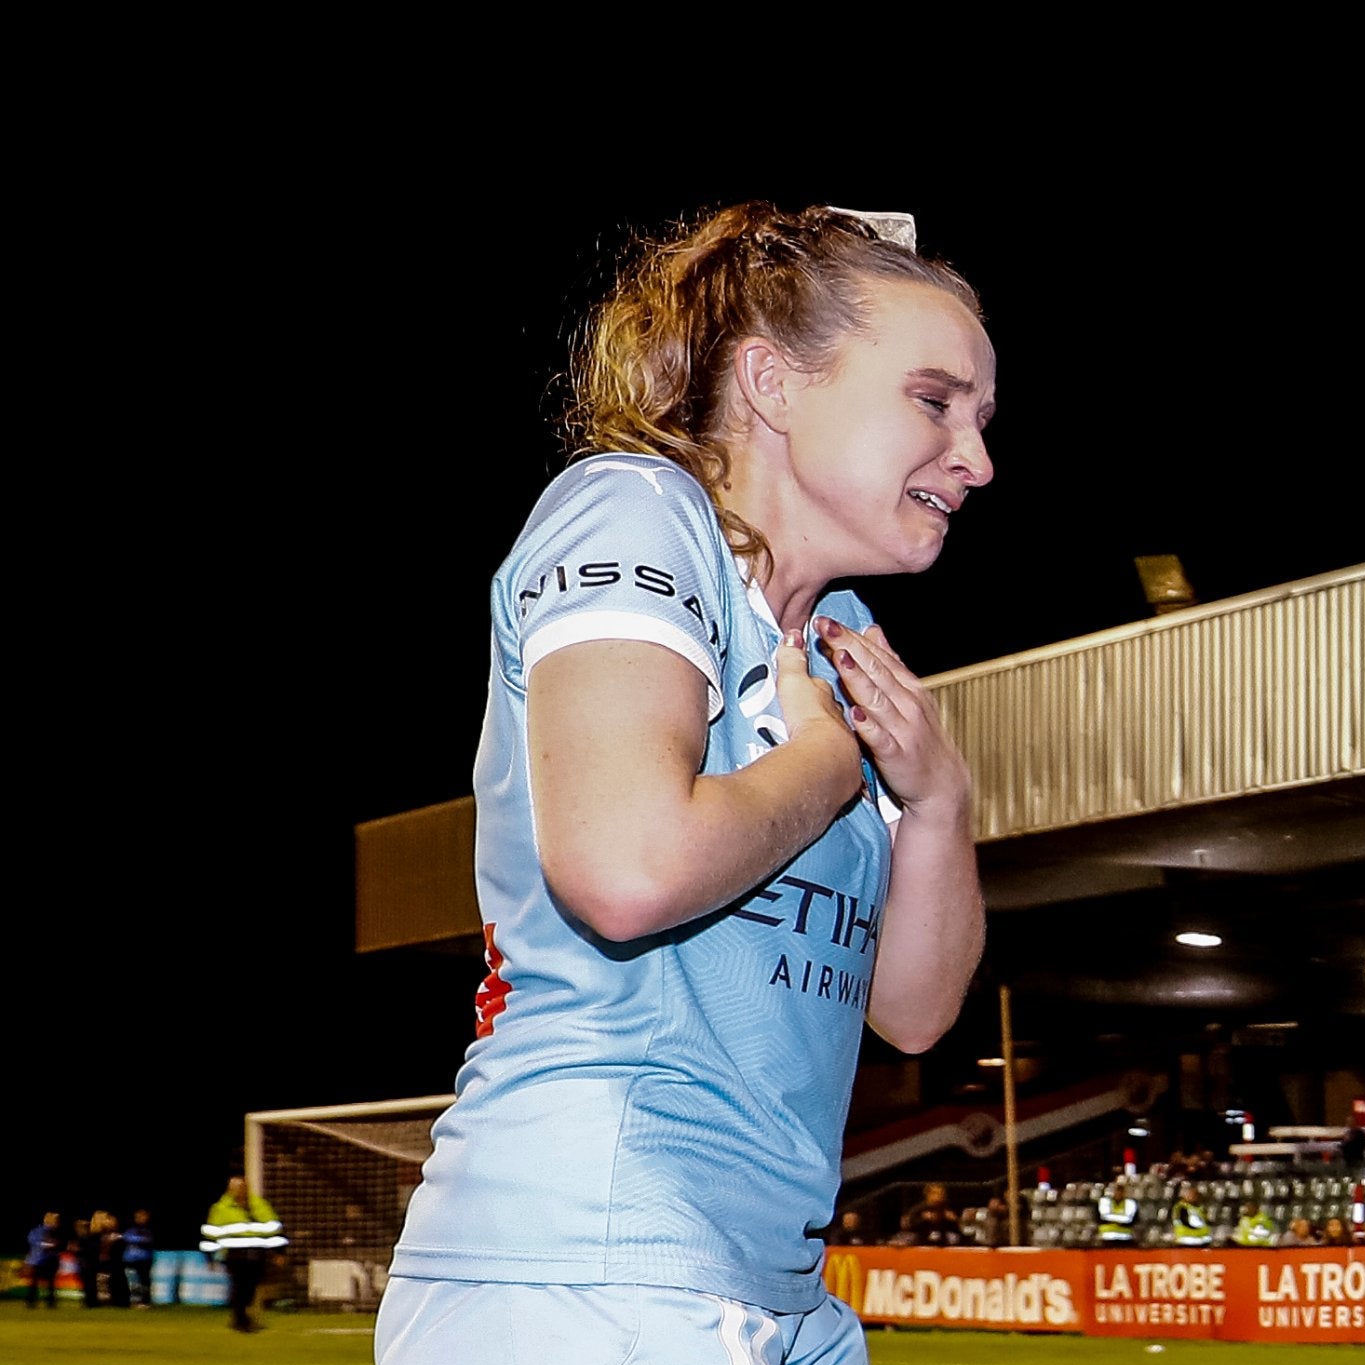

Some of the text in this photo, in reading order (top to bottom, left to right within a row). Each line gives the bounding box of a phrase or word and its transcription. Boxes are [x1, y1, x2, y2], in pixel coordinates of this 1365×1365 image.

[865, 1267, 1077, 1325] McDonald's
[1095, 1263, 1226, 1300] LA TROBE
[1258, 1264, 1299, 1301] LA
[1095, 1303, 1226, 1326] UNIVERSITY
